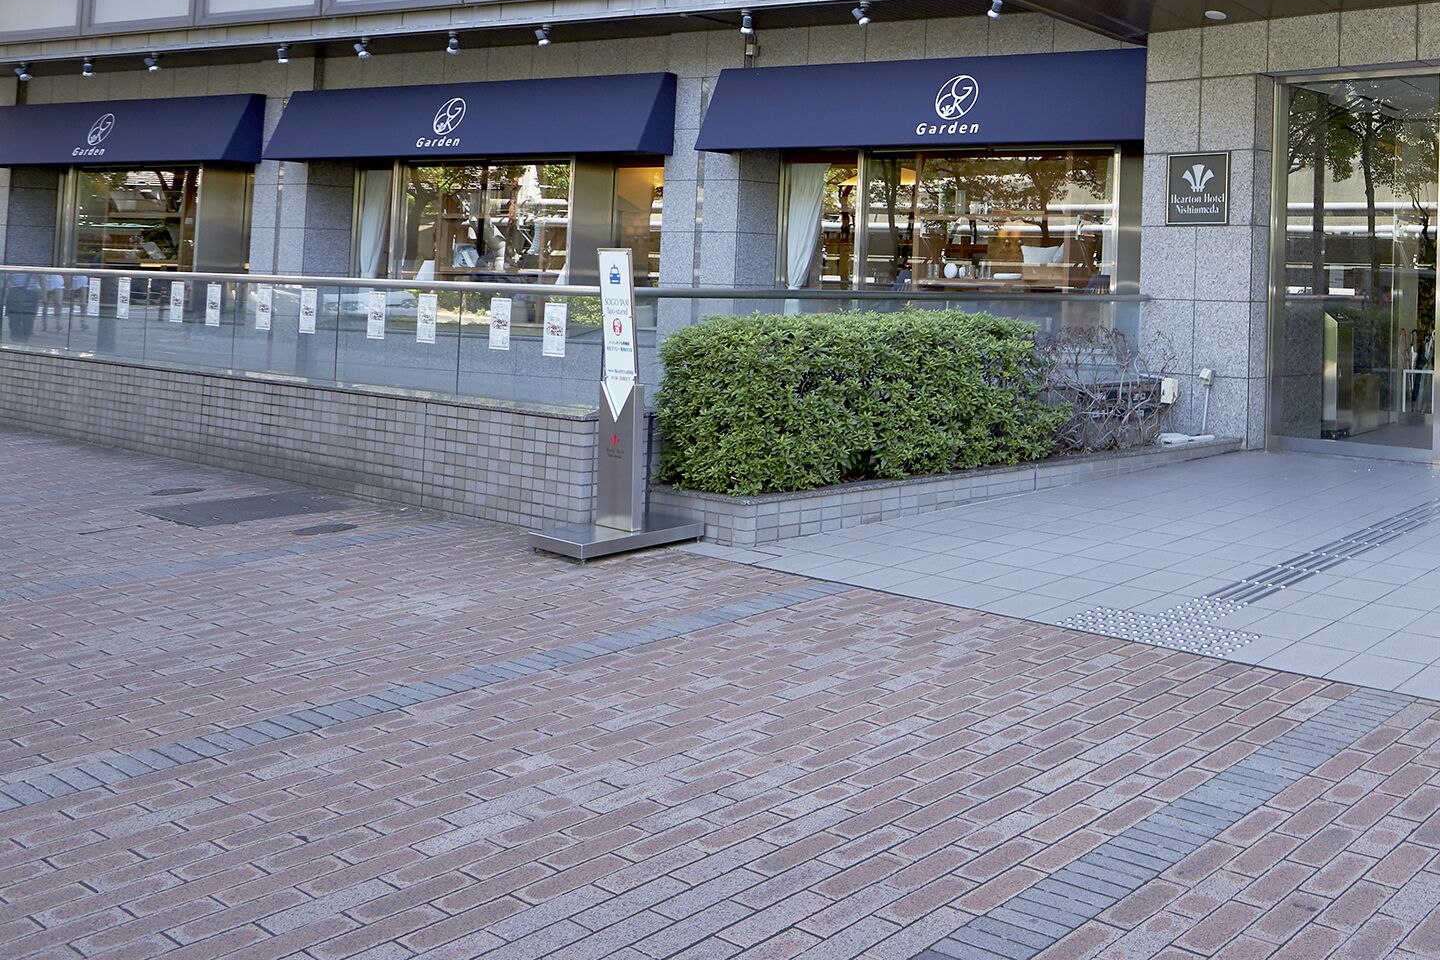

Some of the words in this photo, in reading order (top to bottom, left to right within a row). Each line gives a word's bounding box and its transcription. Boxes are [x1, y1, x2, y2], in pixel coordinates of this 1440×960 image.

[915, 121, 980, 136] Garden
[415, 136, 461, 148] Garden
[72, 146, 106, 156] Garden
[1171, 194, 1202, 204] Hearton
[1204, 193, 1225, 203] Hotel
[1176, 204, 1219, 214] Nishiumeda
